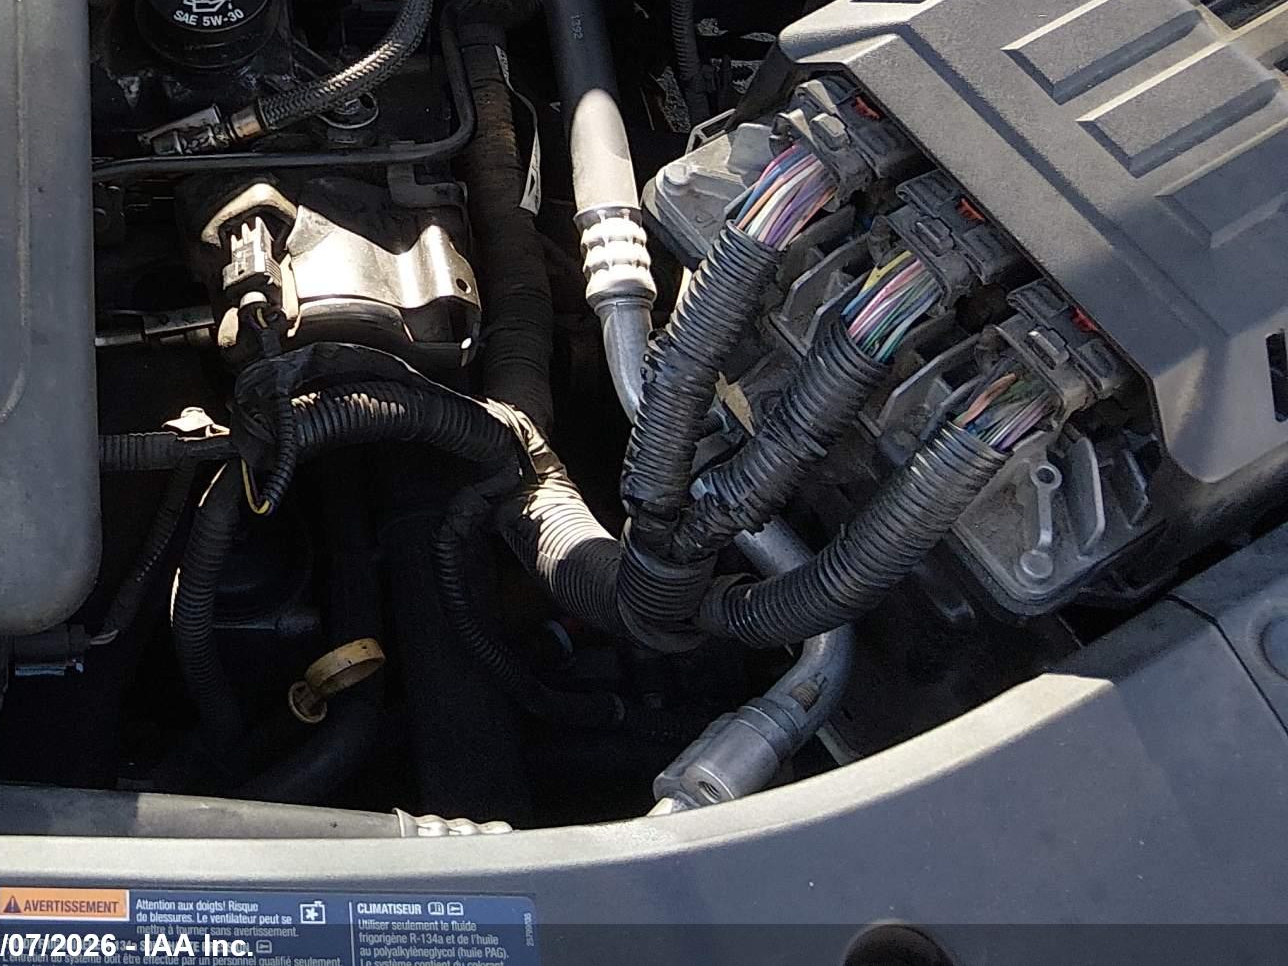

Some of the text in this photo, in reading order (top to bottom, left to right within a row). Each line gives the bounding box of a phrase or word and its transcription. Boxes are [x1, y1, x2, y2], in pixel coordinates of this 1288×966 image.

[173, 9, 244, 26] SAE 5W-30
[23, 899, 120, 914] AVERTISSEMENT
[135, 898, 259, 914] Attention aux doigts! Risque
[357, 903, 423, 915] CLIMATISEUR
[136, 912, 292, 926] de blessures. Le ventilateur peut se
[358, 918, 477, 932] Utiliser seulement le fluide
[136, 923, 166, 935] mettre
[167, 924, 173, 935] à
[175, 924, 209, 936] tourner
[210, 926, 232, 937] sans
[358, 932, 499, 945] frigorigène R-134a et de l'huile
[359, 945, 510, 960] au polyalkylèneglycol (huile PAG).
[181, 956, 197, 966] par
[199, 956, 211, 966] un
[212, 955, 257, 966] personnel
